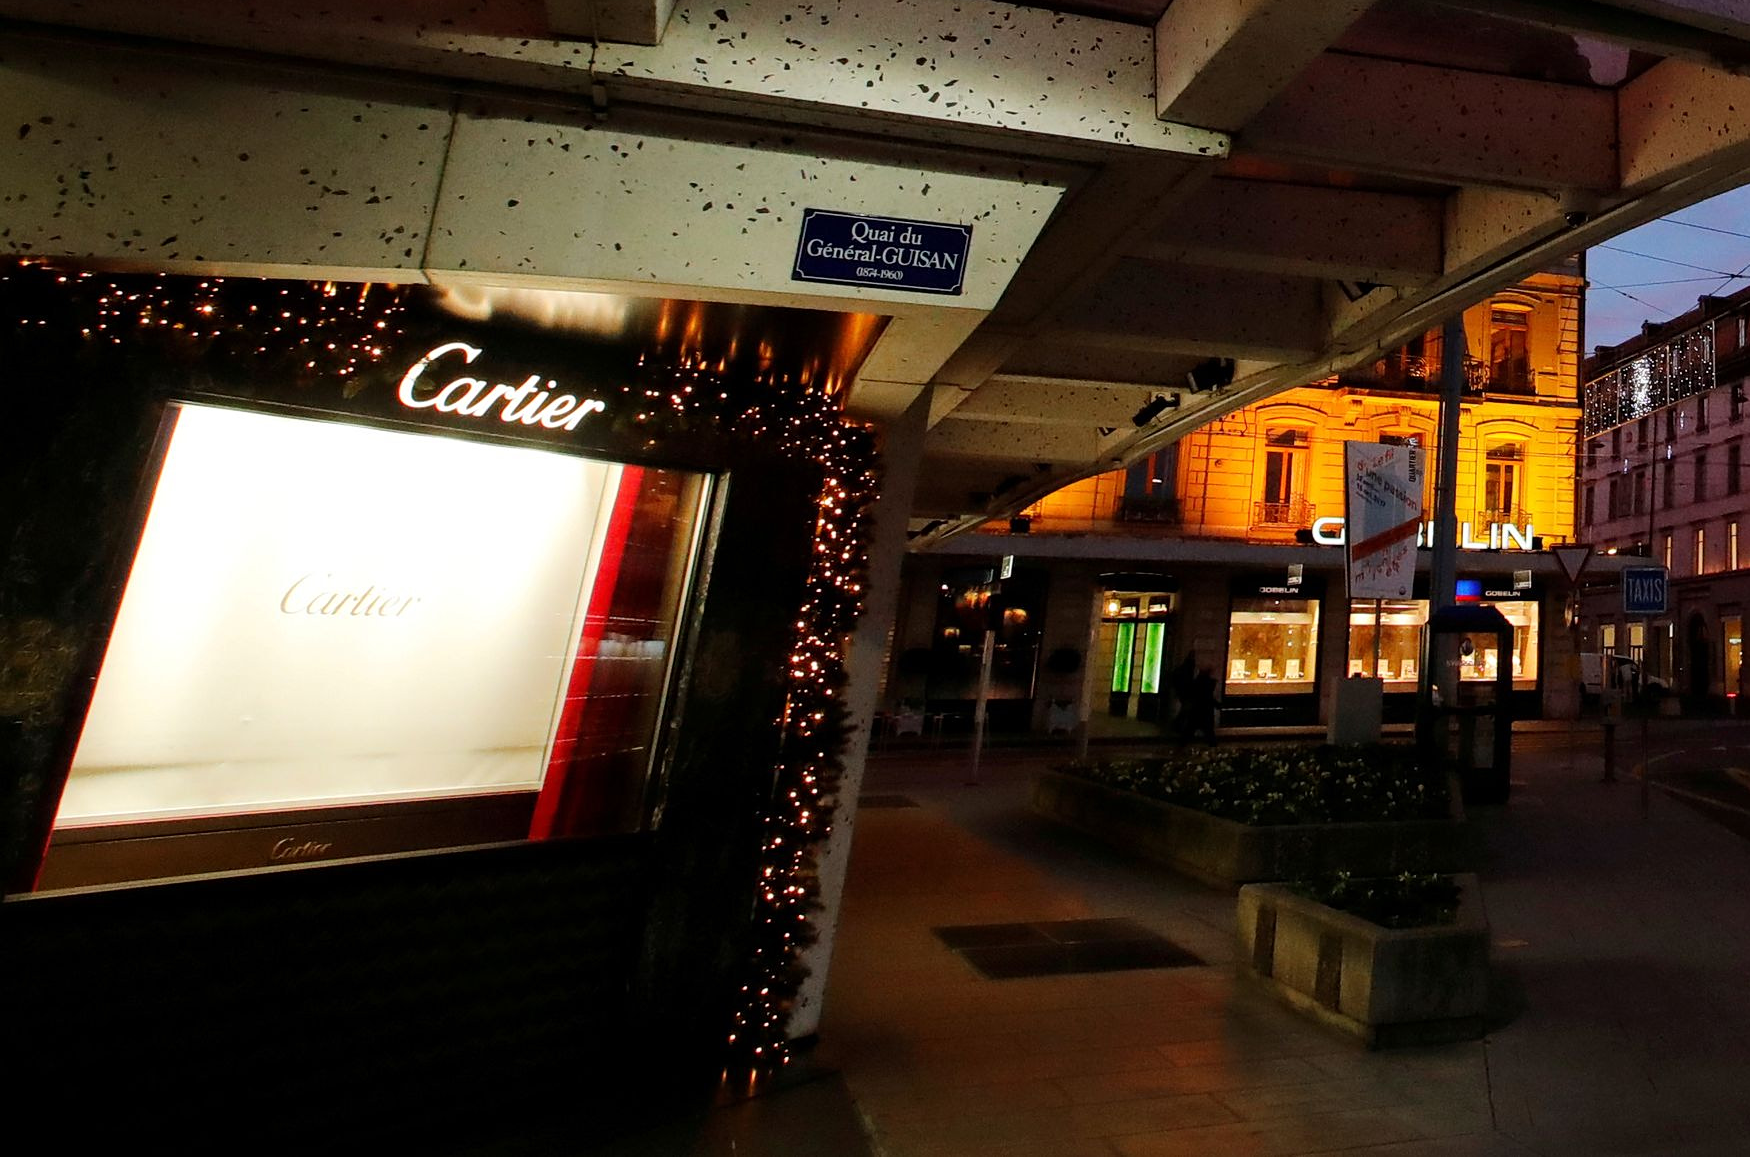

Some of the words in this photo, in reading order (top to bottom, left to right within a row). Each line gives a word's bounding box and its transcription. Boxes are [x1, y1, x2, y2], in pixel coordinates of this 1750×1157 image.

[850, 221, 897, 244] Quai
[898, 226, 923, 245] du
[806, 238, 960, 271] Général-GUISAN
[398, 340, 606, 433] Cartier
[280, 572, 422, 618] Cartier
[1627, 578, 1663, 603] TAXIS
[270, 835, 333, 861] Cartier
